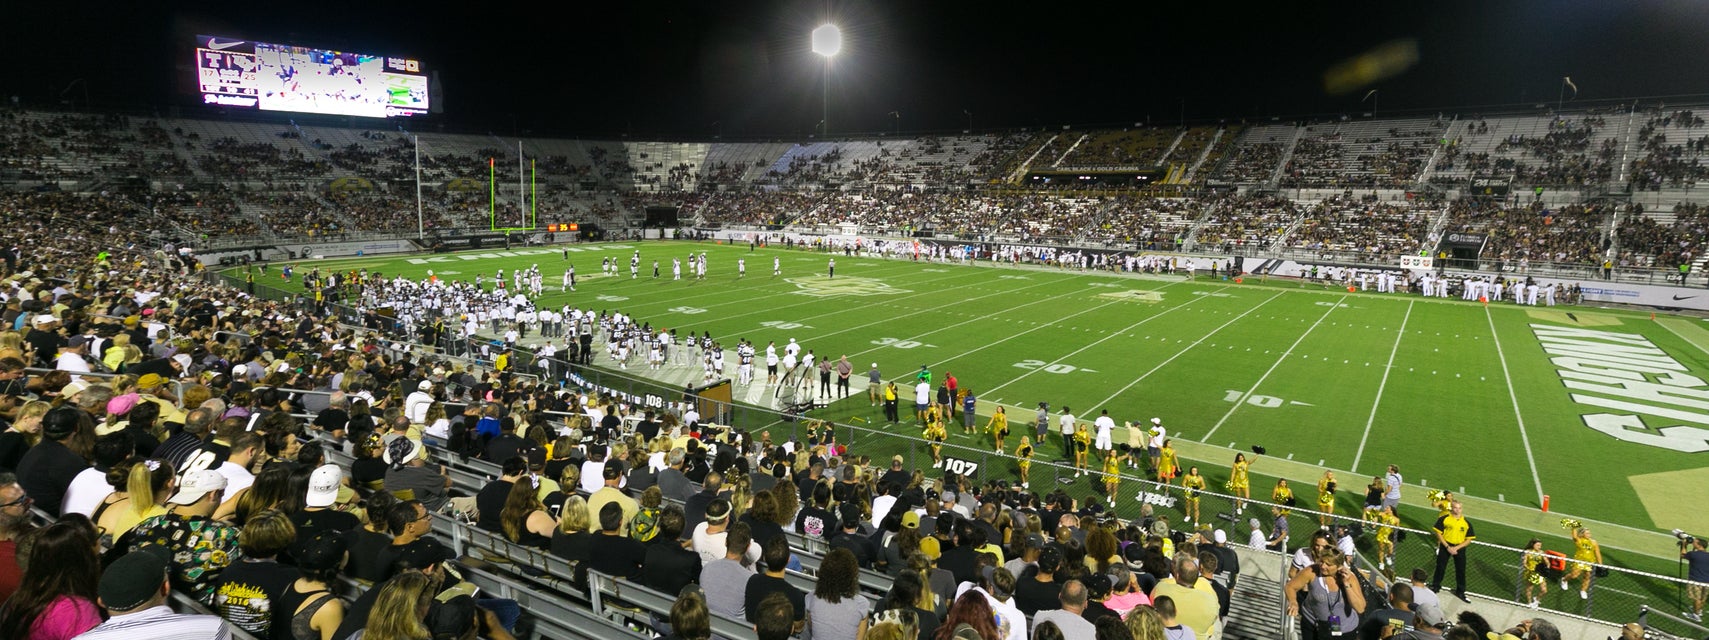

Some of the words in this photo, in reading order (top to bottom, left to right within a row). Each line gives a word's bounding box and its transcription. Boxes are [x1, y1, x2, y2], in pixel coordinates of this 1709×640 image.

[870, 337, 923, 349] 30
[1012, 359, 1077, 375] 20
[645, 393, 663, 408] 108
[1223, 389, 1285, 408] 10
[945, 457, 978, 476] 107
[226, 596, 249, 606] 2016
